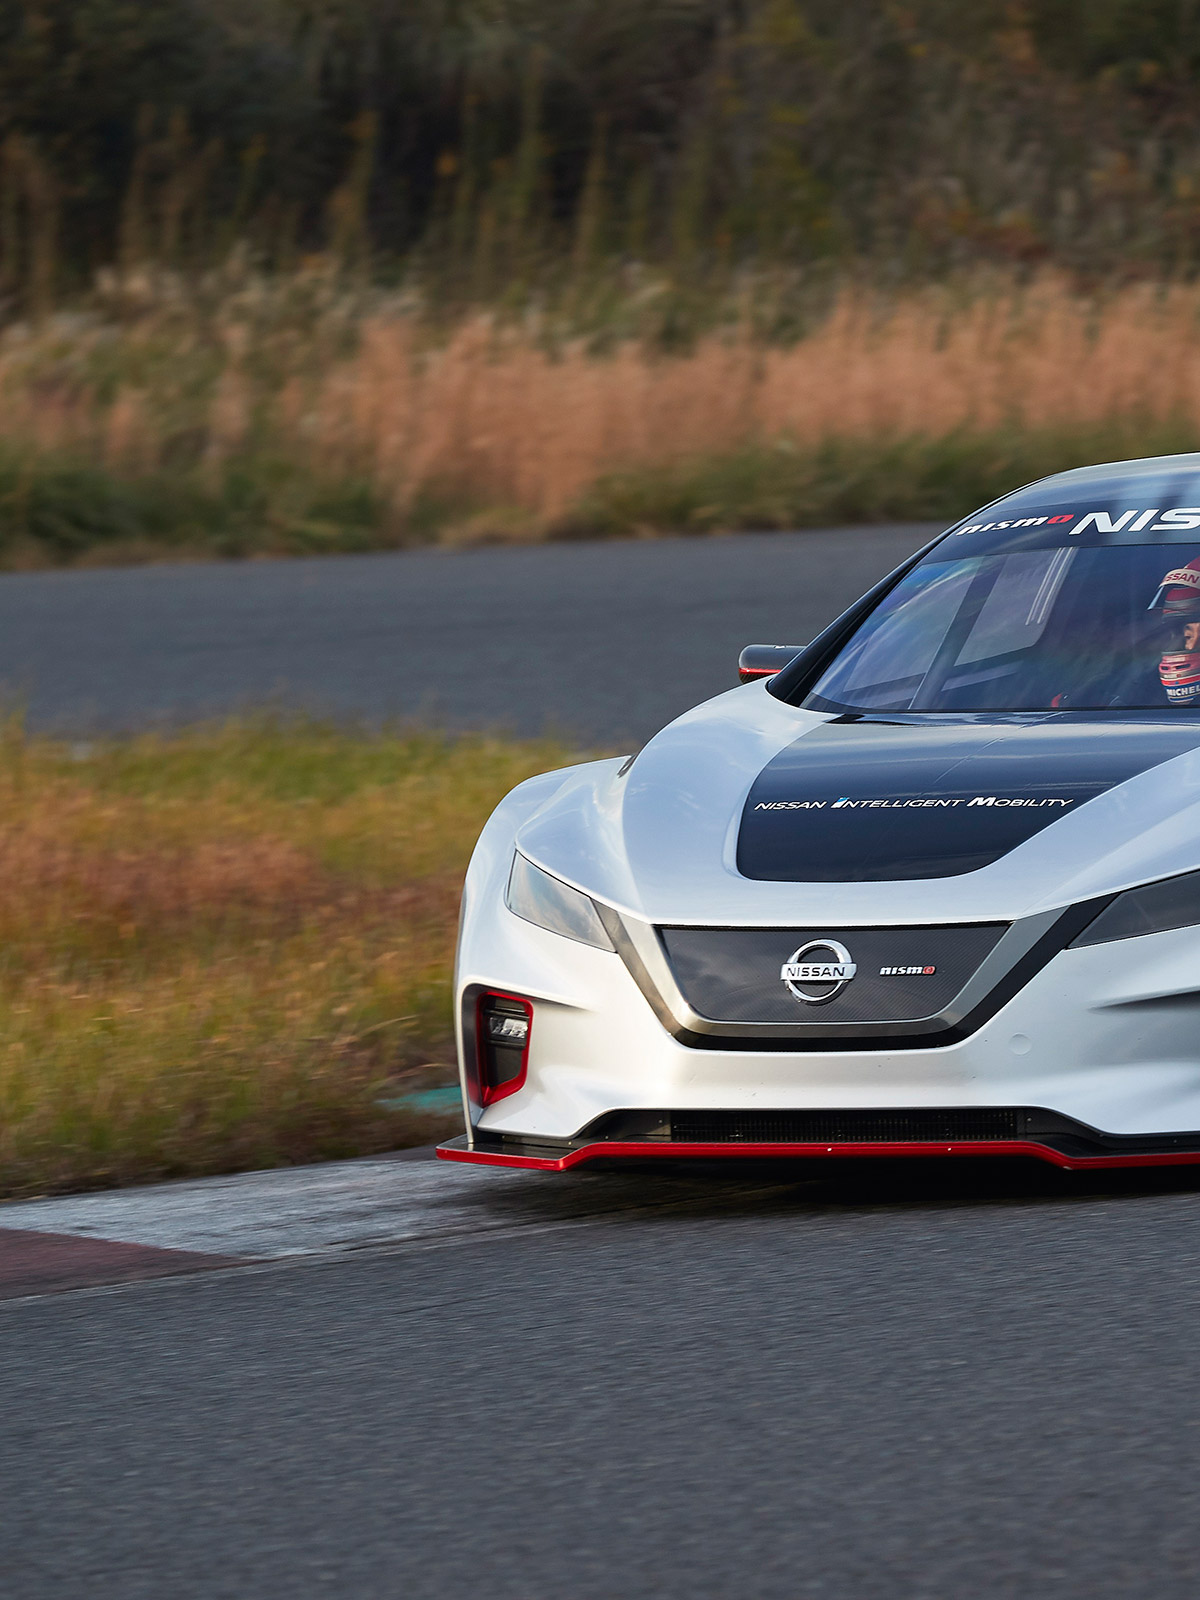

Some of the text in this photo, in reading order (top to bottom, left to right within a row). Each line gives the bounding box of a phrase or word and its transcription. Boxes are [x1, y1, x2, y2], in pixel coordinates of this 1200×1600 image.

[956, 514, 1075, 536] nismo
[754, 796, 1074, 811] NISSAN INTELLIGENT MOBILITY
[786, 966, 846, 978] NISSAN
[879, 965, 936, 977] nismo
